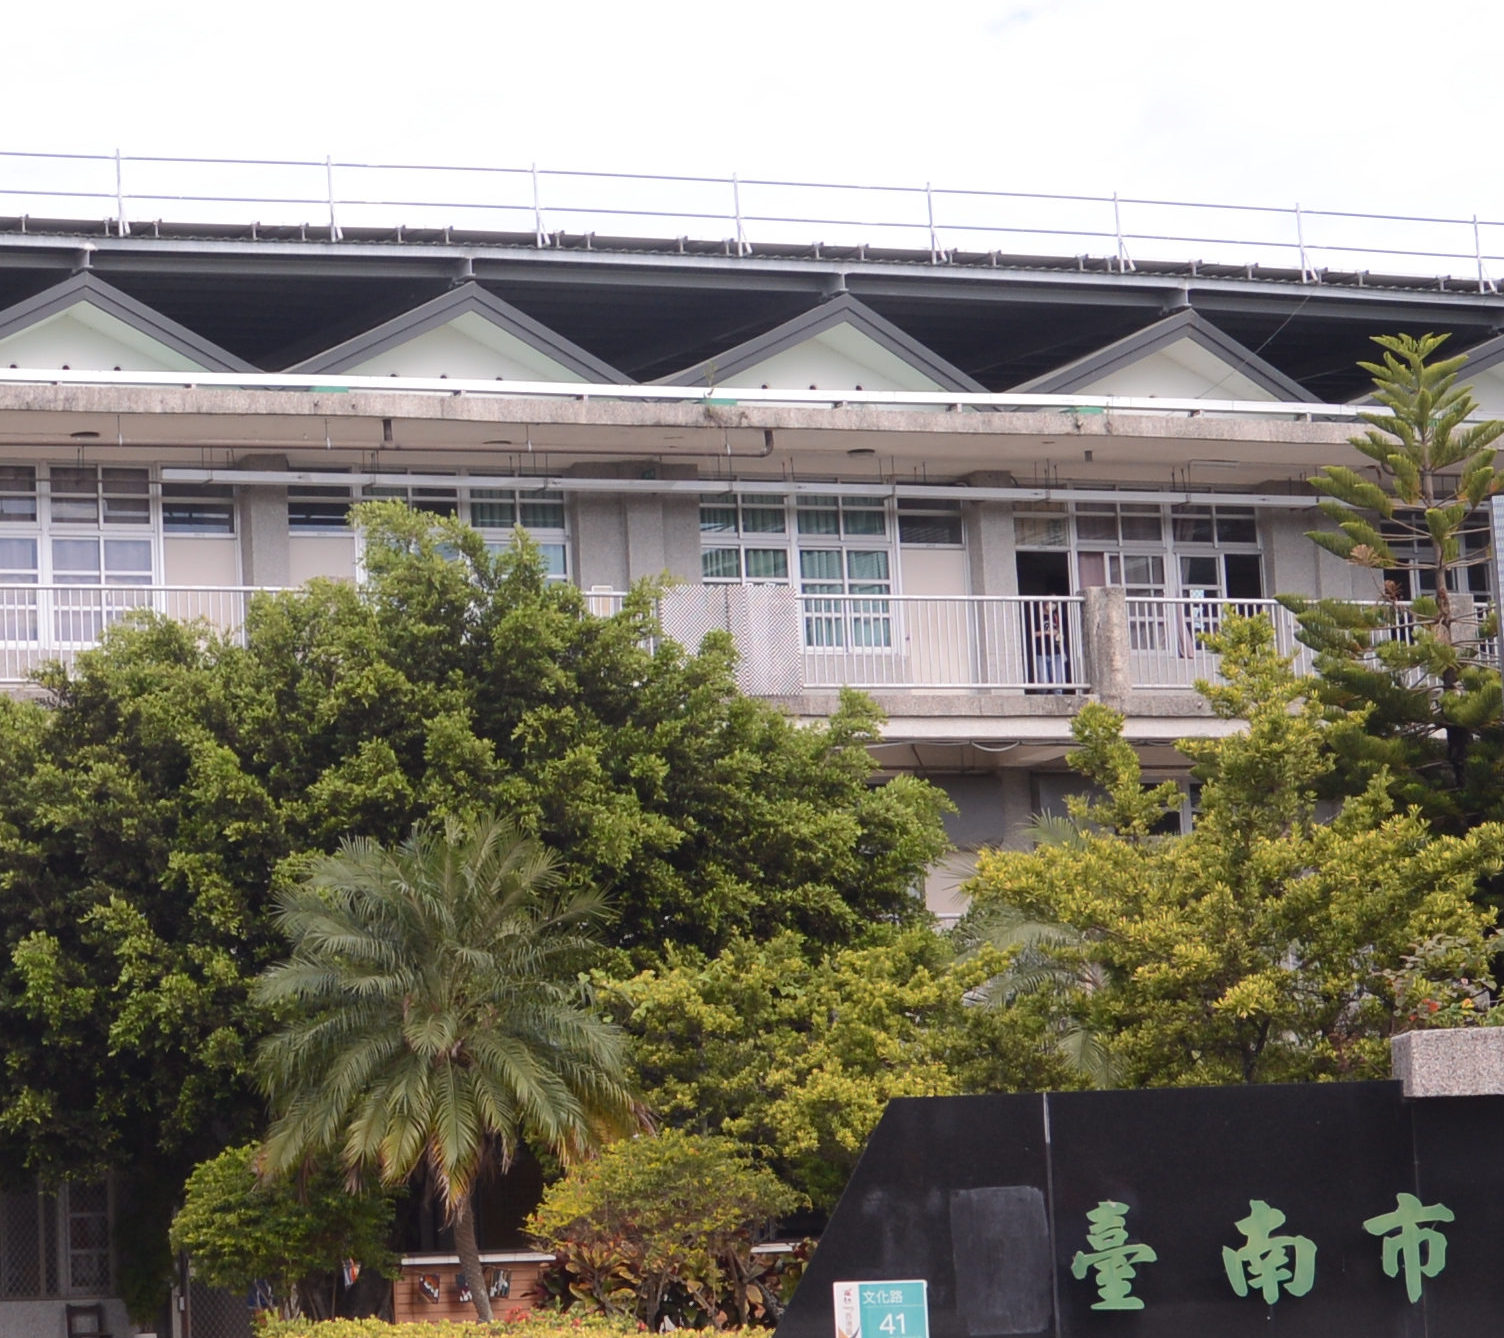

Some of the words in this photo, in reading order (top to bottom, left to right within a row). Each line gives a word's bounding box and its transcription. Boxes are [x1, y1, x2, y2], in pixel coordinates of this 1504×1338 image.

[862, 1289, 903, 1305] 文化路
[879, 1312, 906, 1335] 41
